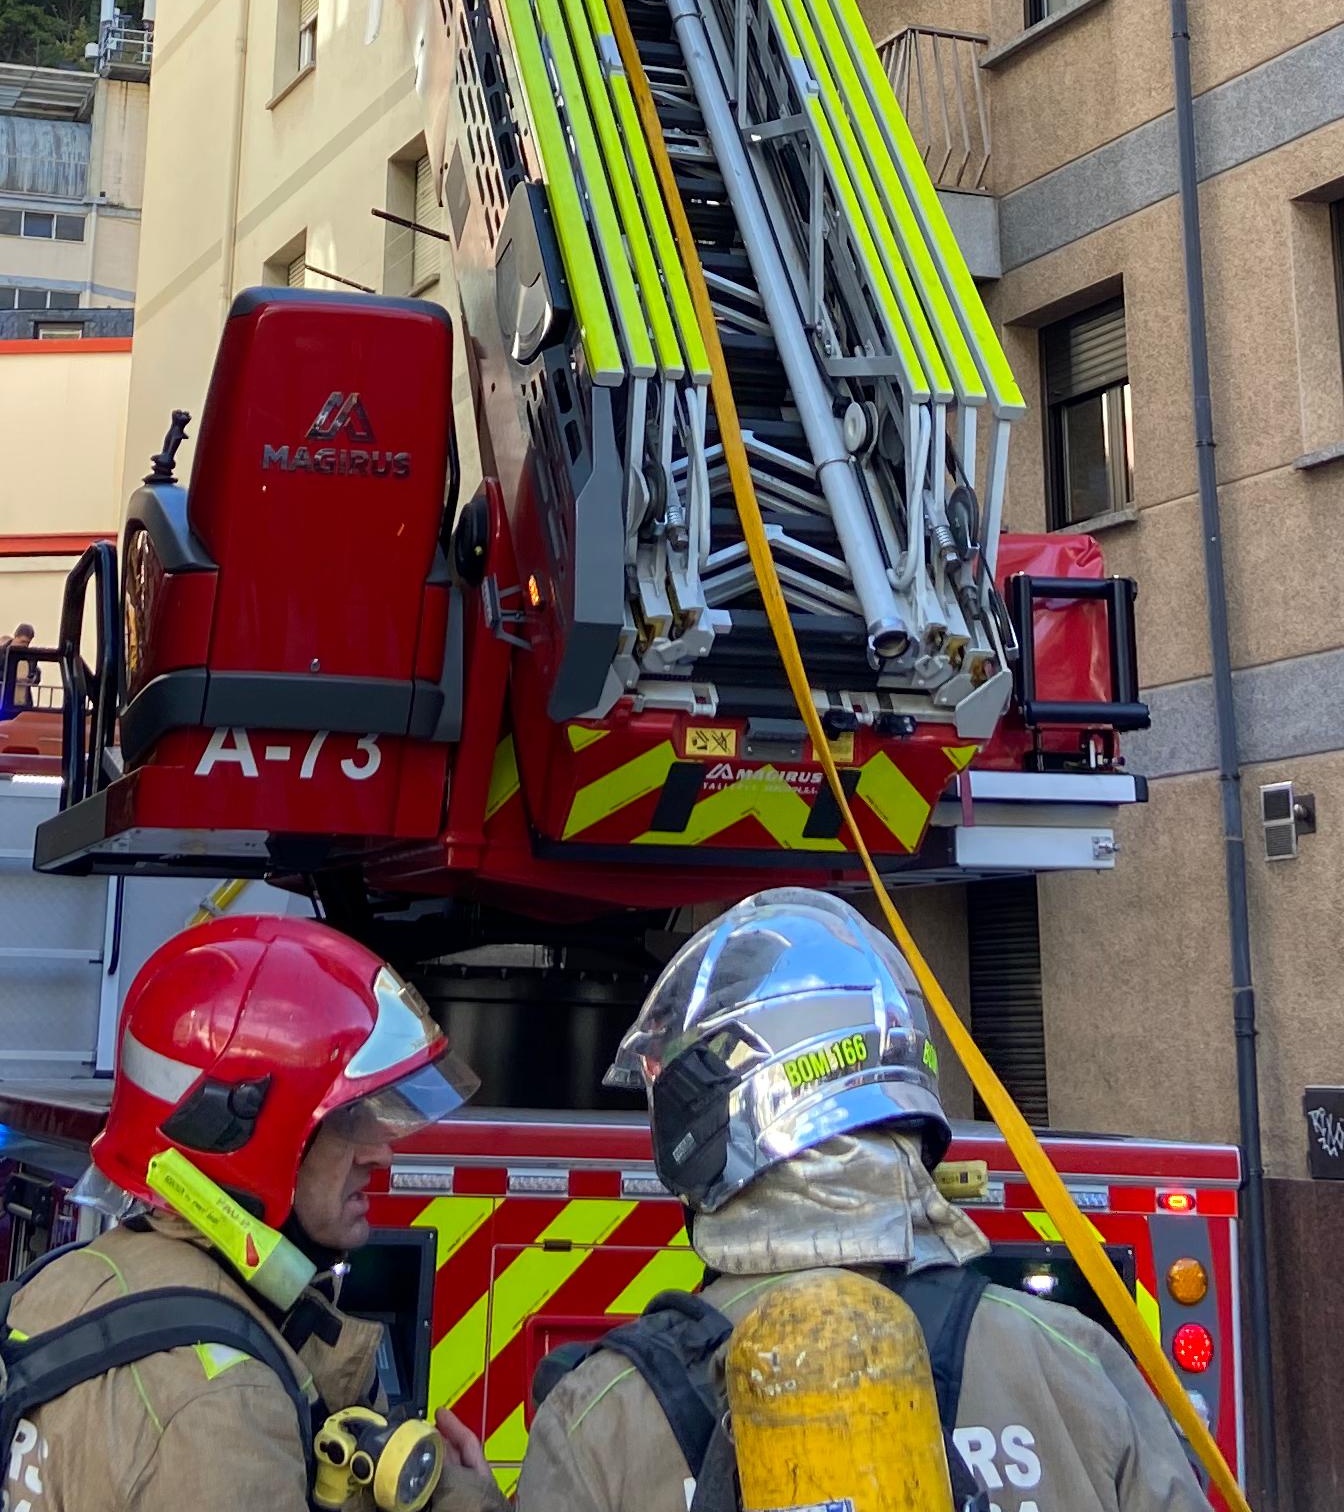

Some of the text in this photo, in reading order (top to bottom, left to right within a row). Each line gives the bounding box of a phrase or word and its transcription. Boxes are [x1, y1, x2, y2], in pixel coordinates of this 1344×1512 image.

[261, 443, 413, 478] MAGIRUS
[193, 726, 382, 780] A-73
[783, 1033, 869, 1089] BOM 166
